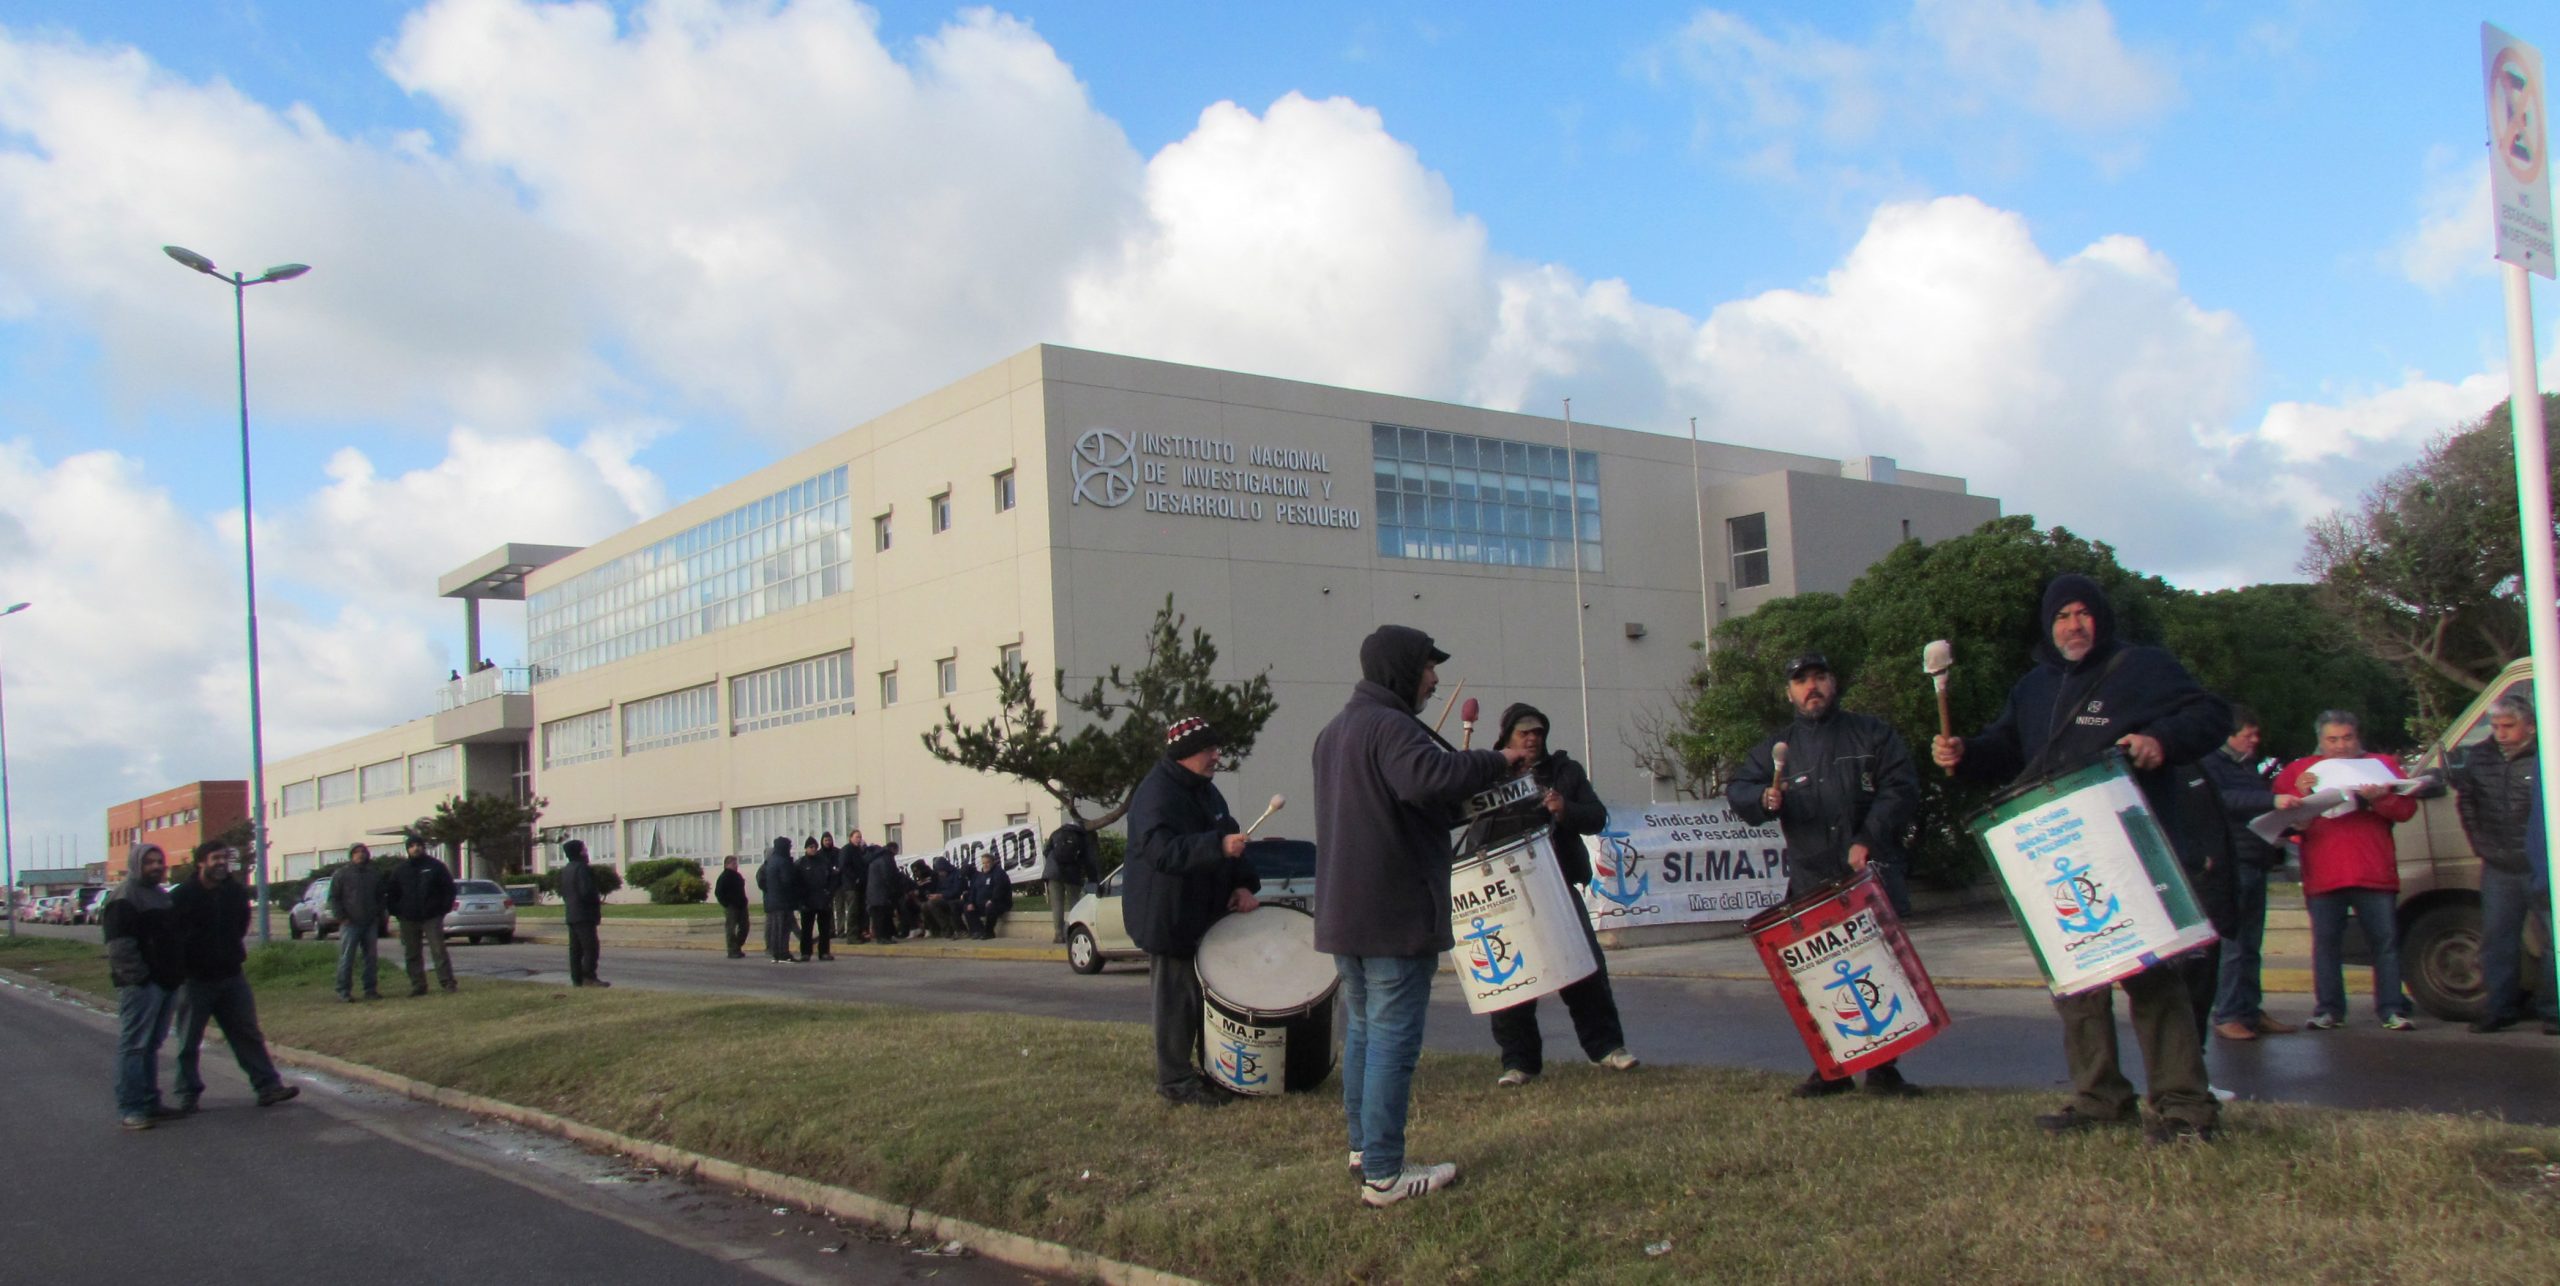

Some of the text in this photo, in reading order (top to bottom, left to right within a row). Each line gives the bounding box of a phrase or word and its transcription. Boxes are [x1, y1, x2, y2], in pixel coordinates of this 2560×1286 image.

[1142, 432, 1330, 473] INSTITUTO NACIONAL
[1143, 461, 1332, 501] DE INVESTIGACION Y
[1145, 489, 1360, 529] DESARROLLO PESQUERO
[1644, 812, 1719, 827] Sindicato
[1671, 827, 1780, 842] de Pescadores
[1688, 890, 1783, 911] Mar del Plata
